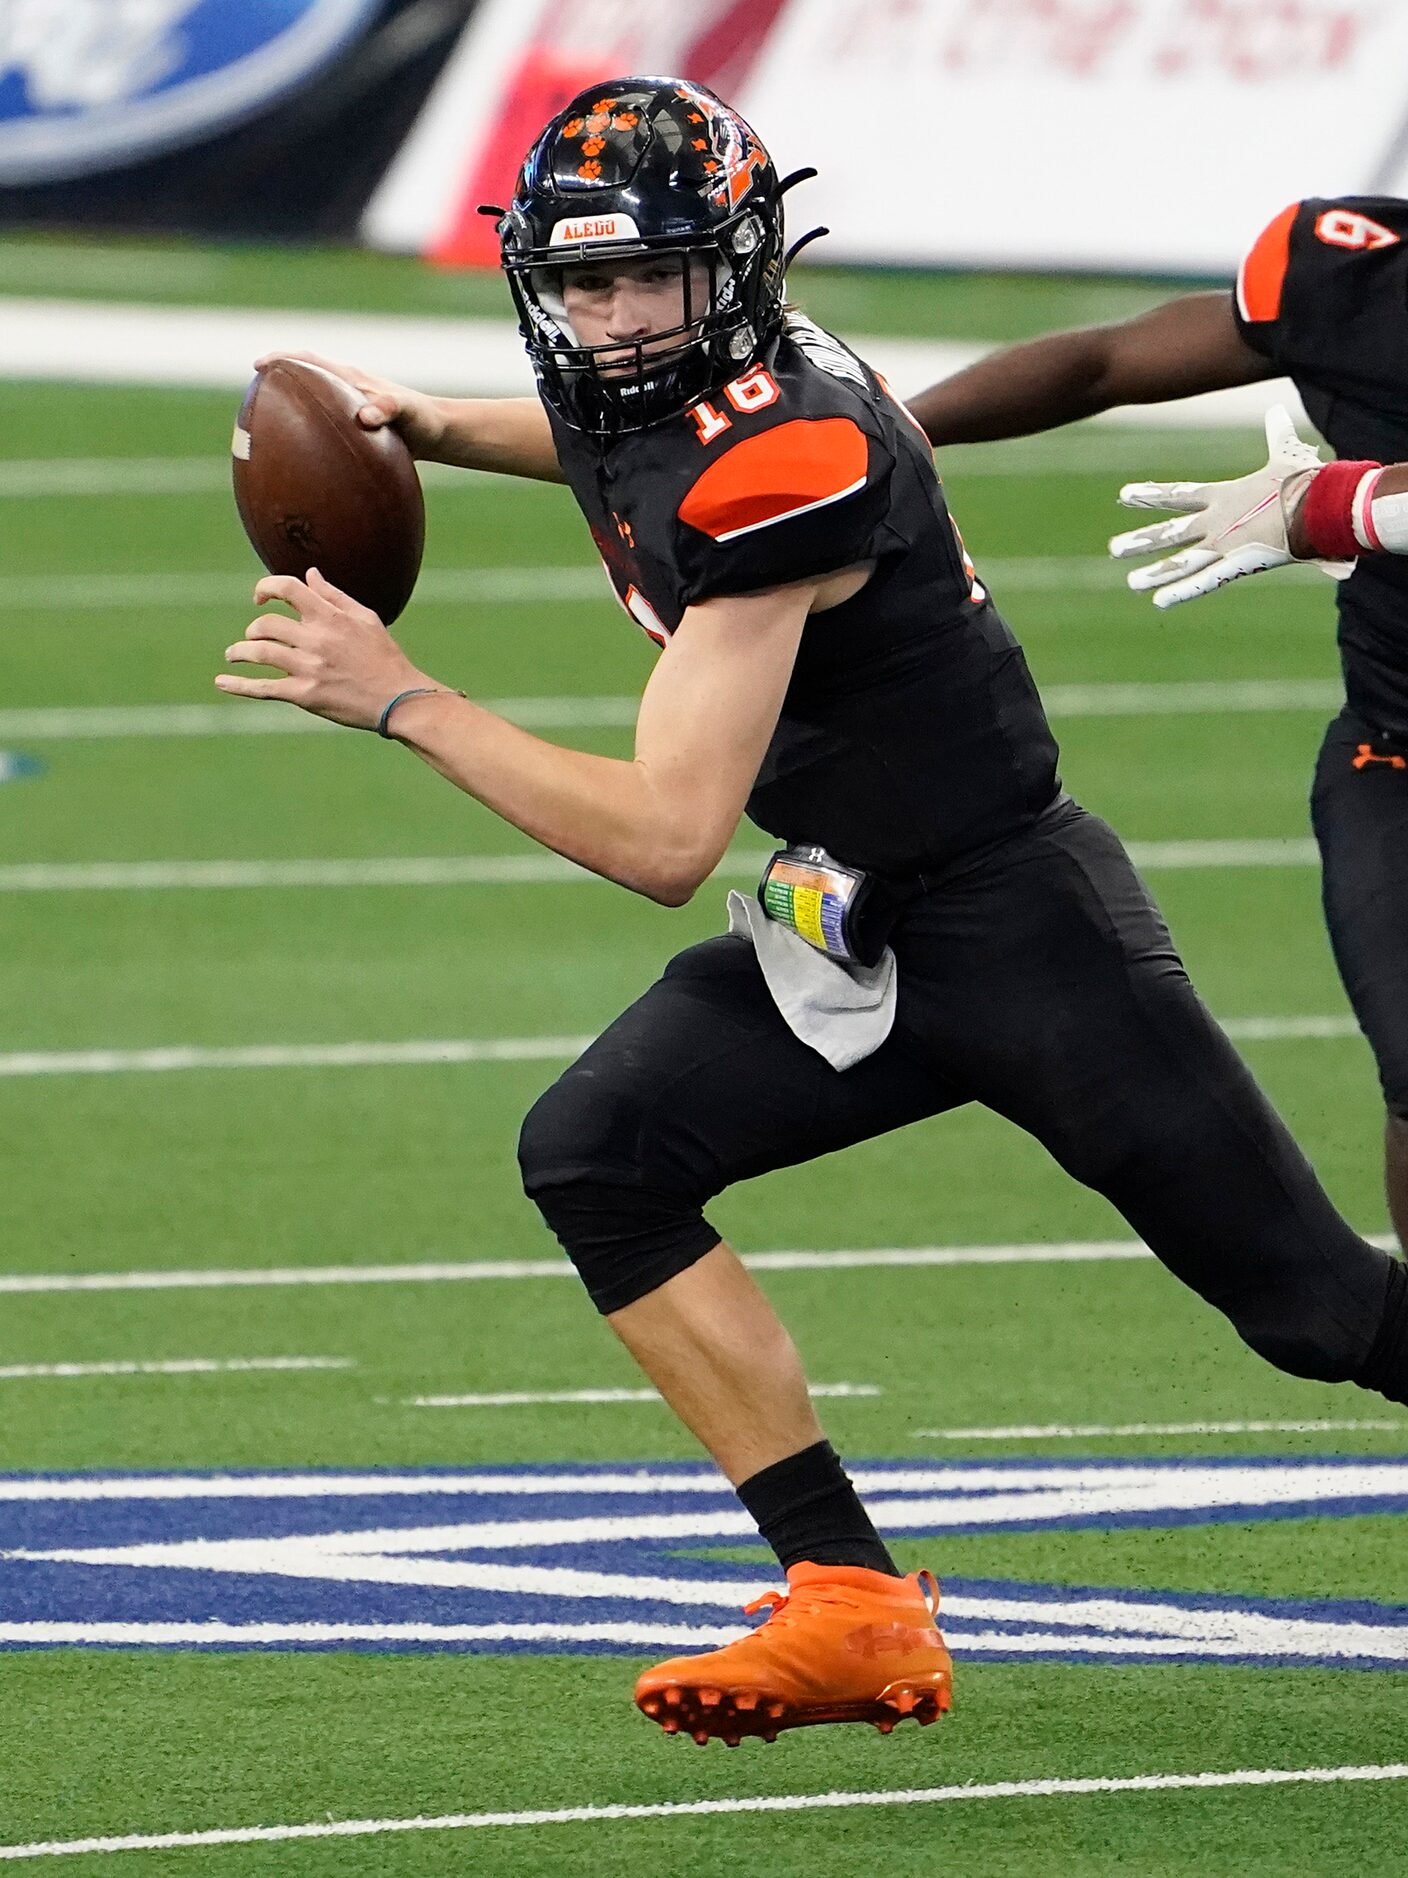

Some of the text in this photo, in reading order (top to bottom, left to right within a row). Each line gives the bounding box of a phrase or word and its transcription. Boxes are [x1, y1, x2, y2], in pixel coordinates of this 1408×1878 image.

[563, 219, 616, 240] ALEDO
[1314, 209, 1399, 250] 6
[685, 362, 781, 446] 16
